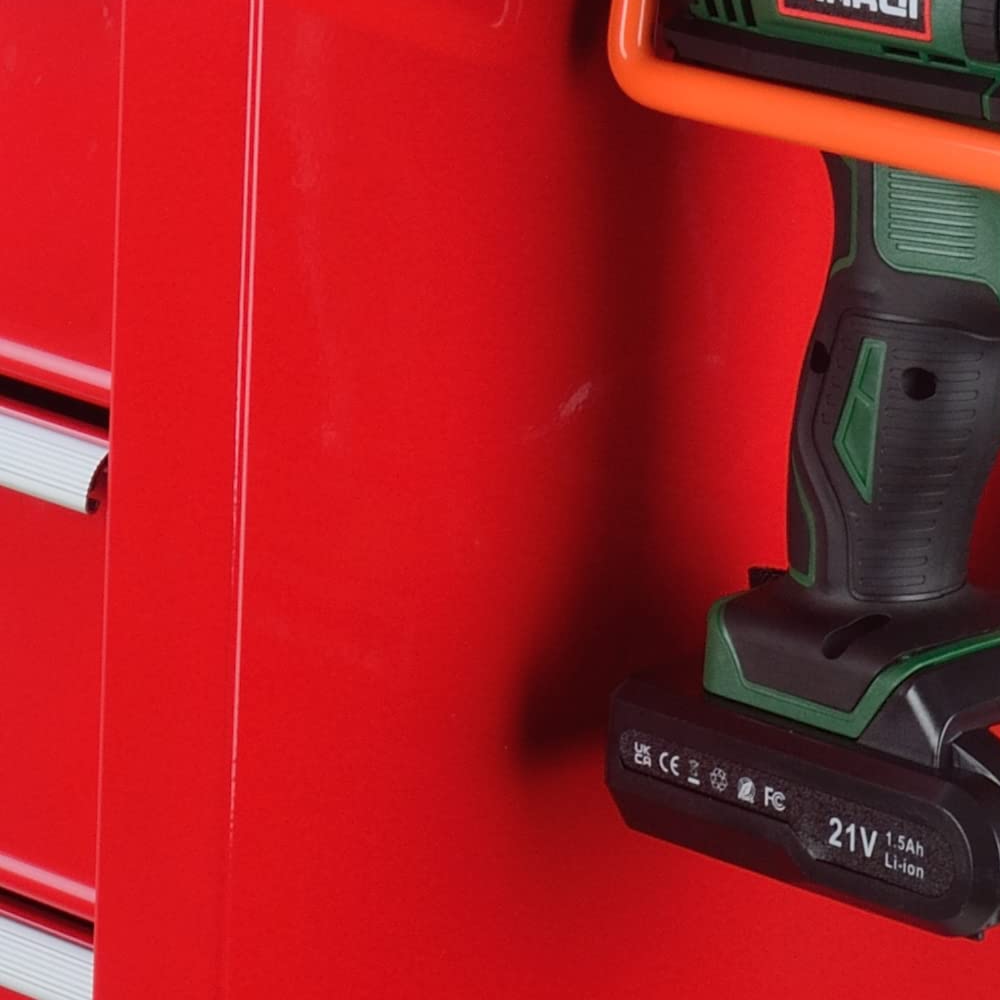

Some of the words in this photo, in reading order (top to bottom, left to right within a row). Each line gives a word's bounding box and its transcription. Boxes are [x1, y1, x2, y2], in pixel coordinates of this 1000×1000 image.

[829, 817, 878, 858] 21V
[886, 831, 924, 857] 1.5Ah
[884, 851, 924, 879] Li-ion
